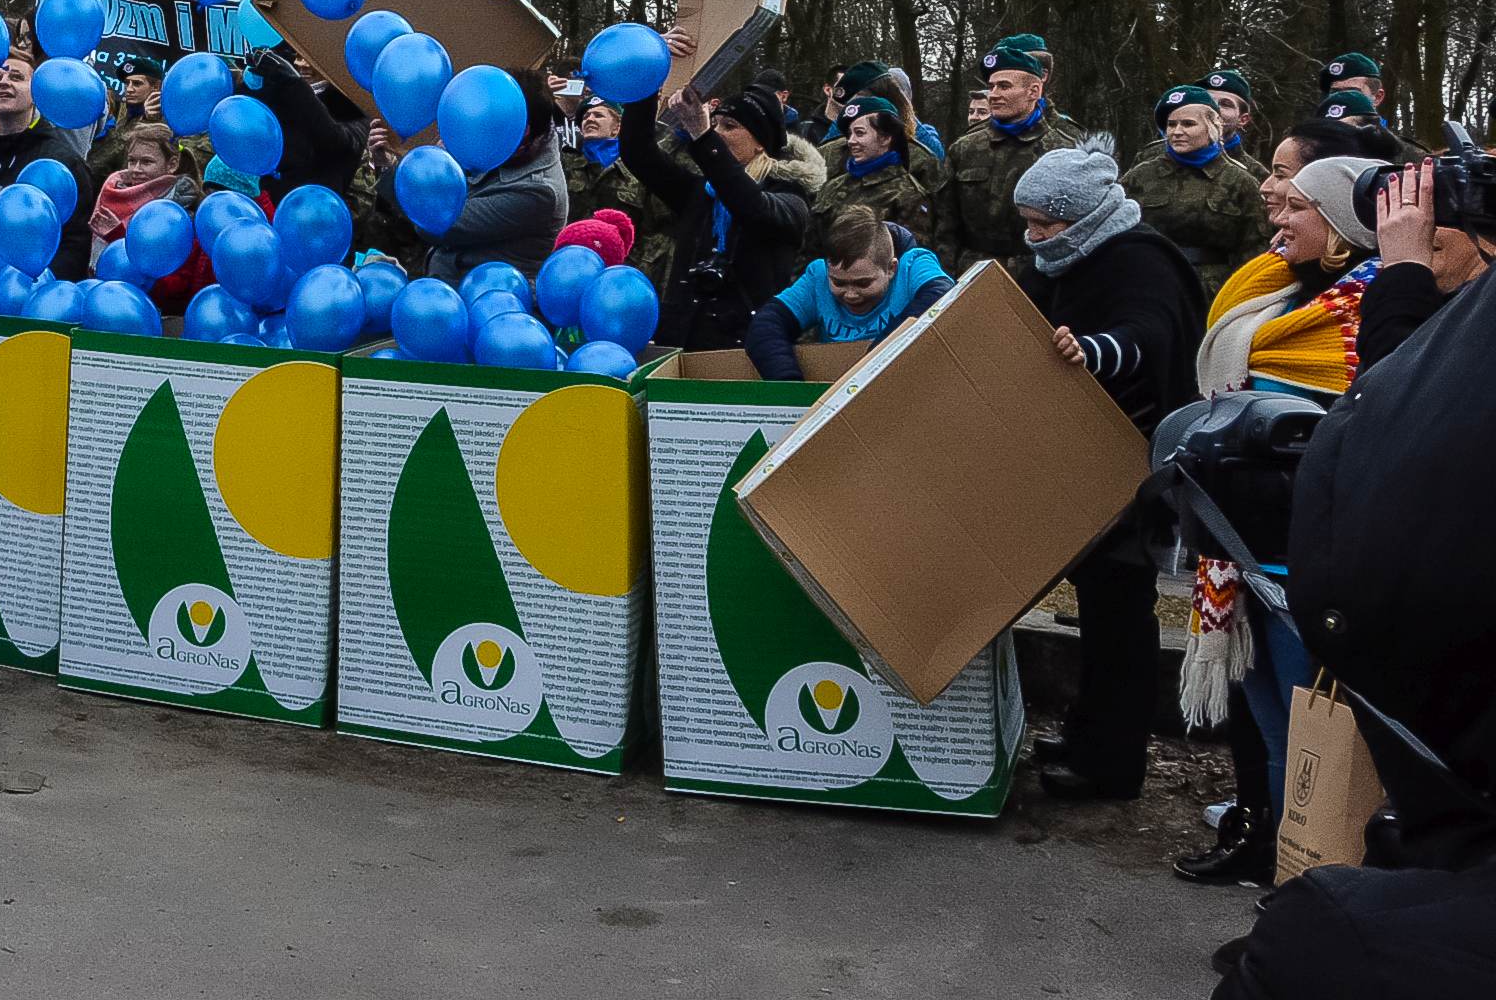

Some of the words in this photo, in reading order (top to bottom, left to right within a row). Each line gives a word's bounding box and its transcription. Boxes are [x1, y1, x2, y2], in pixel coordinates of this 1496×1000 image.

[175, 0, 195, 51] i
[348, 419, 367, 428] quality
[348, 438, 367, 447] quality
[658, 446, 678, 455] quality
[700, 448, 724, 456] nasiona
[659, 467, 679, 476] quality
[701, 469, 725, 477] nasiona
[682, 582, 706, 590] nasiona
[527, 592, 556, 600] guarantee
[570, 595, 591, 604] highest
[593, 599, 614, 608] quality
[544, 602, 566, 611] highest
[568, 606, 588, 615] quality
[527, 611, 556, 620] guarantee
[570, 615, 591, 624] highest
[593, 619, 614, 628] quality
[527, 631, 555, 640] guarantee
[569, 634, 590, 644] highest
[592, 639, 613, 648] quality
[544, 641, 566, 651] highest
[567, 646, 588, 655] quality
[568, 654, 590, 664] highest
[592, 659, 613, 668] quality
[345, 665, 364, 674] quality
[386, 671, 407, 679] nasiona
[362, 677, 384, 685] nasiona
[568, 674, 590, 684] highest
[591, 678, 612, 688] quality
[345, 684, 364, 693] quality
[385, 690, 407, 698] nasiona
[543, 681, 565, 690] highest
[566, 685, 587, 695] quality
[566, 705, 586, 714] quality
[687, 706, 711, 714] nasiona
[567, 713, 589, 723] highest
[590, 718, 611, 728] quality
[668, 715, 689, 724] quality
[714, 718, 738, 726] nasiona
[688, 726, 712, 735] nasiona
[669, 735, 690, 745] quality
[714, 739, 739, 747] nasiona
